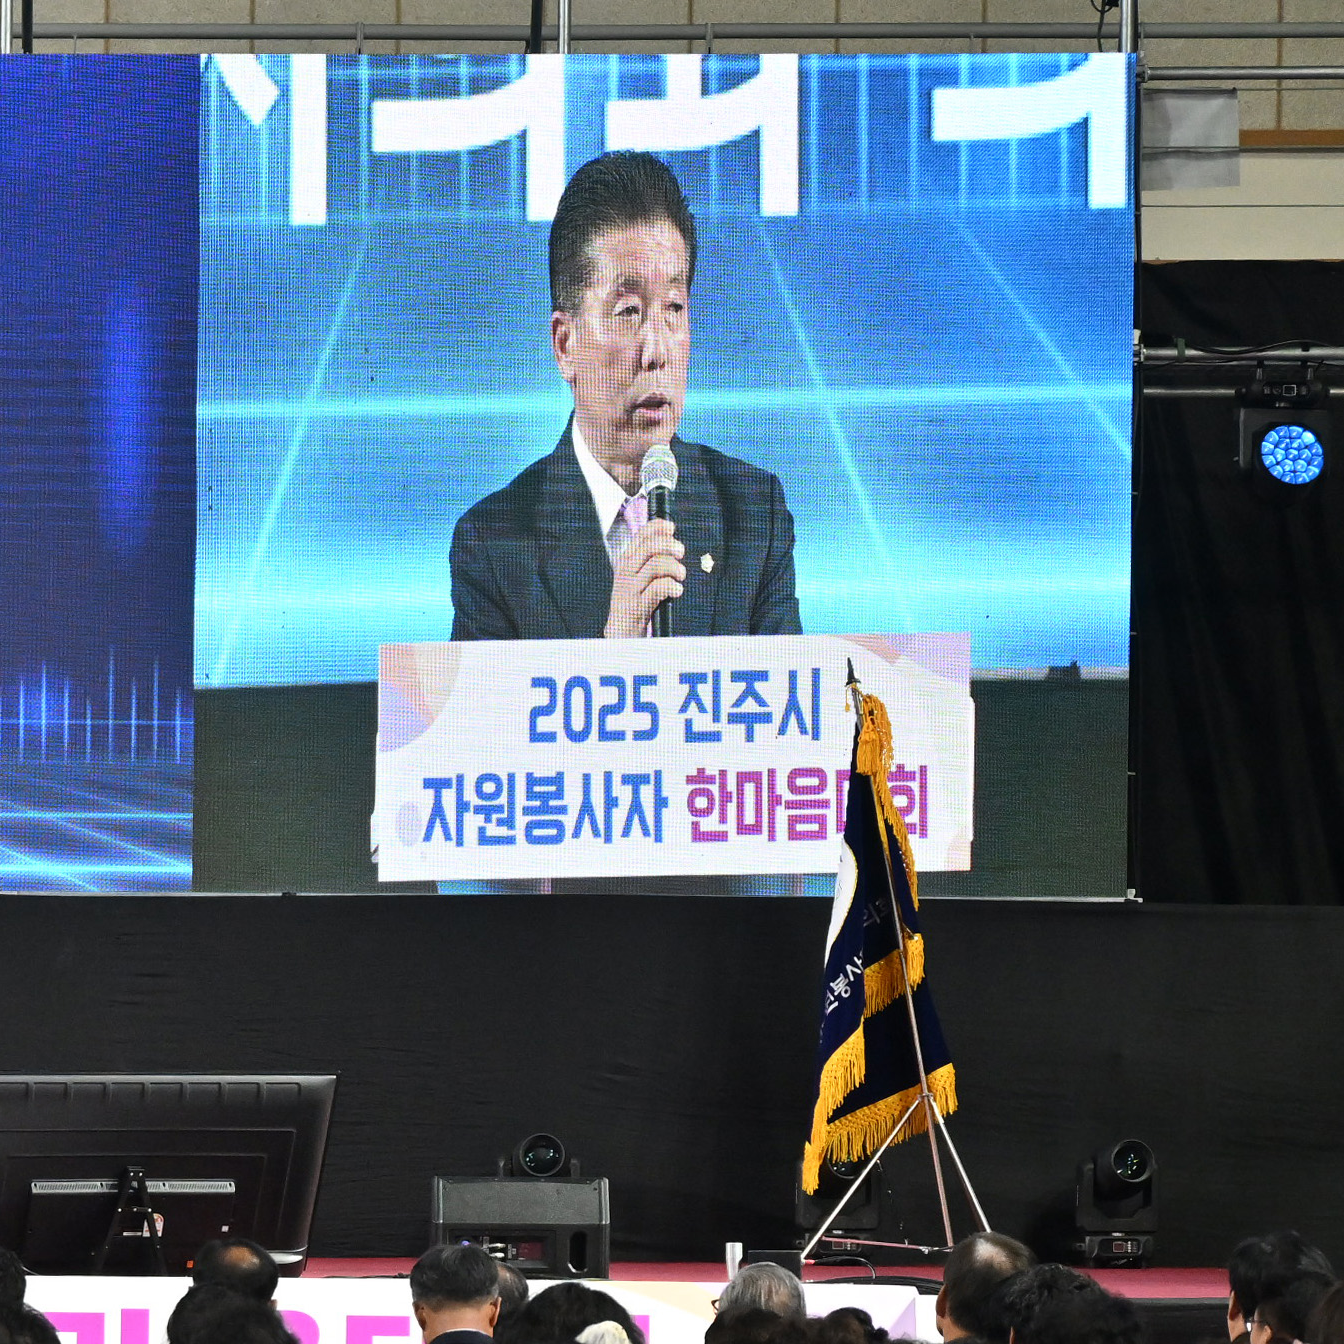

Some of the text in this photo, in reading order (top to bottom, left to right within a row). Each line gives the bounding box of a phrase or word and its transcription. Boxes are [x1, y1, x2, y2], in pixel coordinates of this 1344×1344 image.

[529, 668, 821, 744] 2025 진주시
[422, 764, 928, 848] 자원봉사자 한마음회
